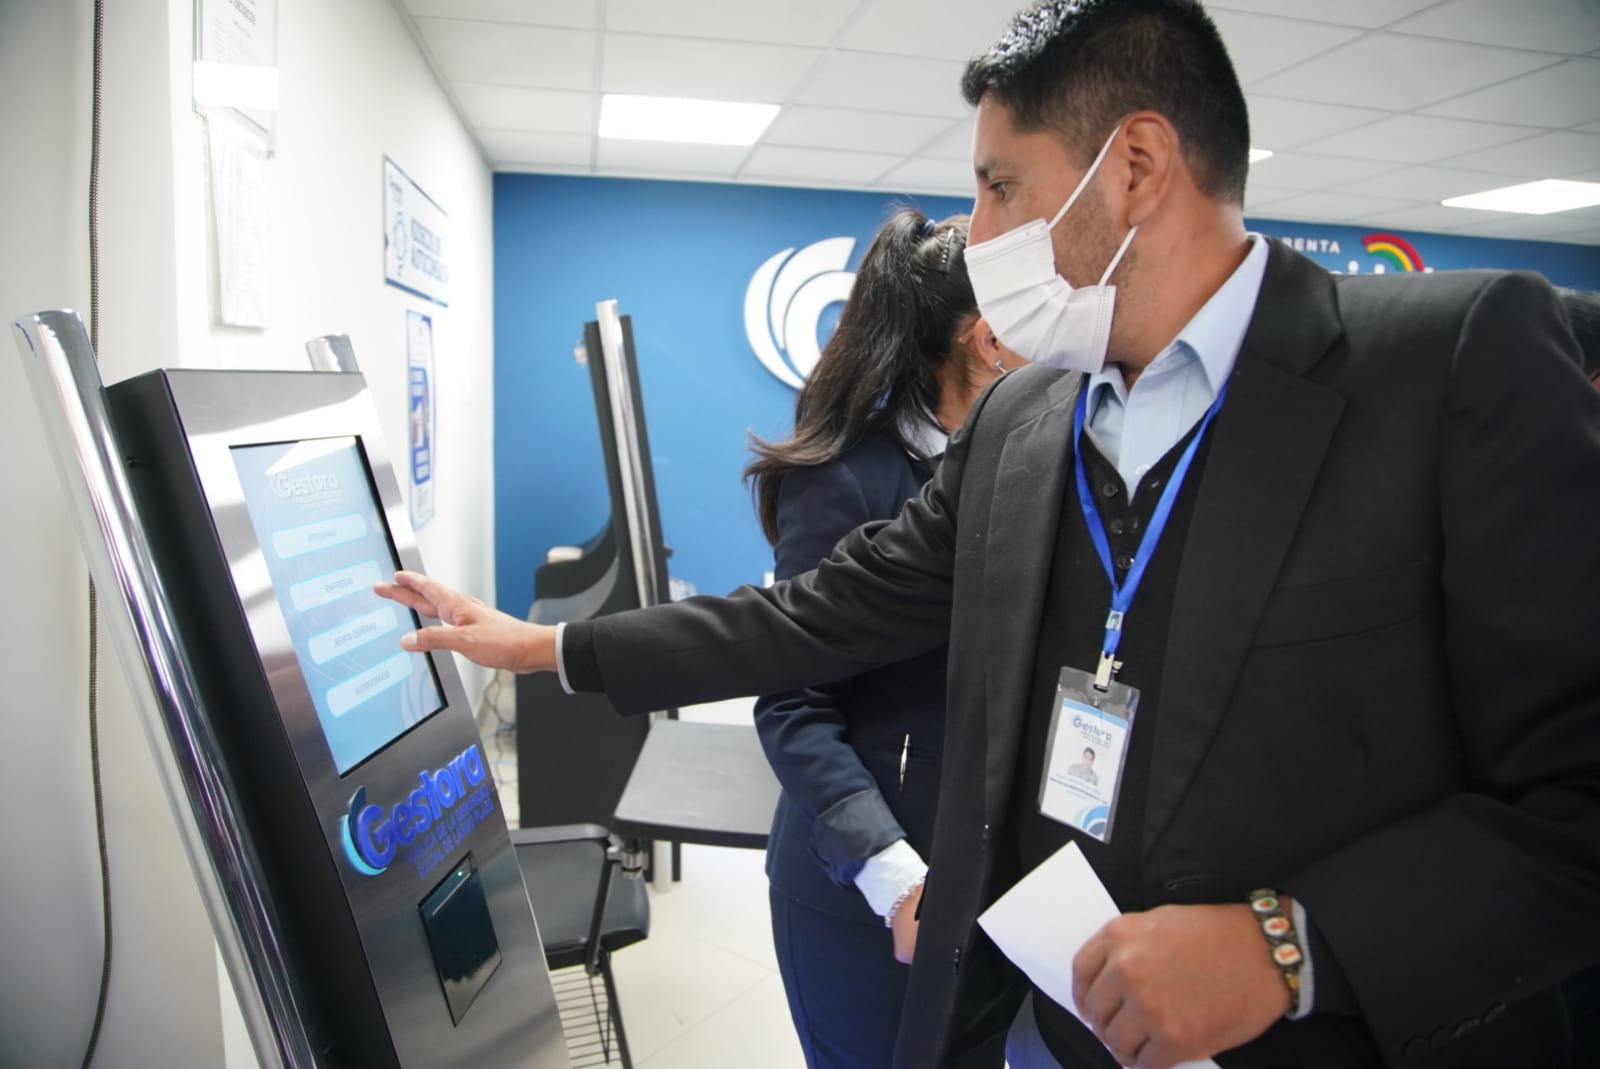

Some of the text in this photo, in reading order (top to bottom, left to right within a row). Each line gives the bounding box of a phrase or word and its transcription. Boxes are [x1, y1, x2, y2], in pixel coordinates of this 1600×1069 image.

[1281, 237, 1340, 254] RENTA
[276, 471, 340, 497] Gestora
[1072, 716, 1113, 741] Gestora
[357, 744, 486, 869] Gestora
